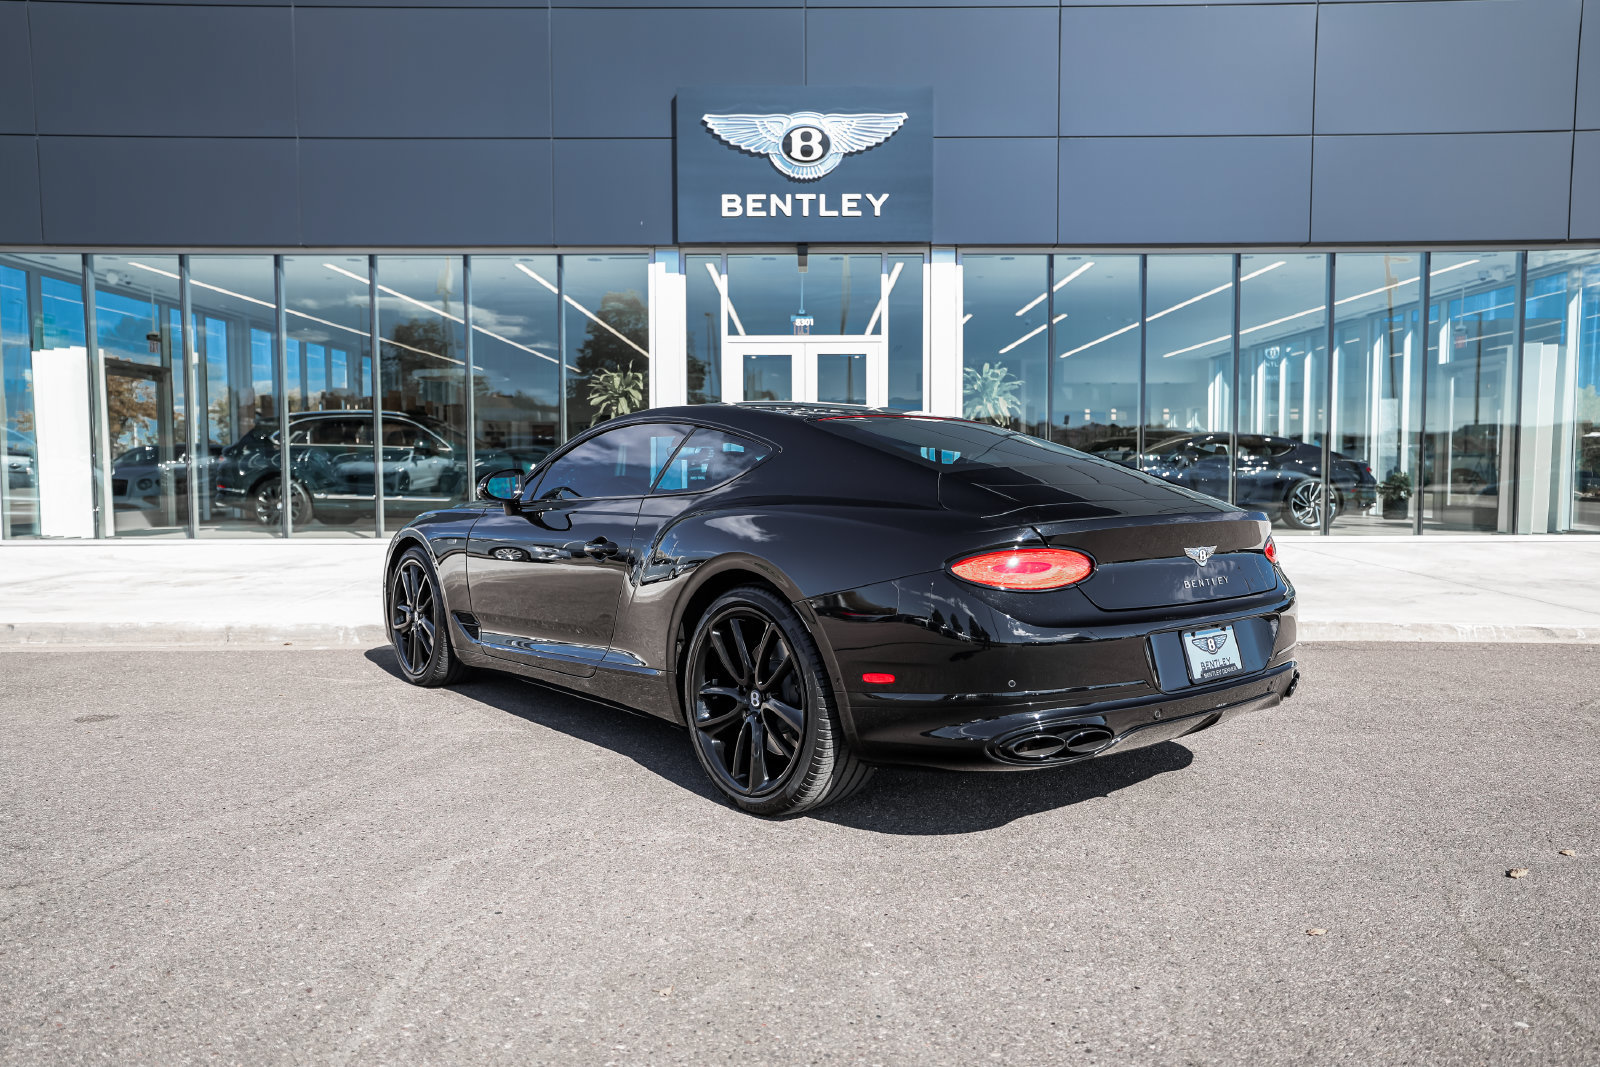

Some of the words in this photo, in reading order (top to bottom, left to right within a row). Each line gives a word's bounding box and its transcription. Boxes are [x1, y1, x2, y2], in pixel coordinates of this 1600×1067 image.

[789, 127, 823, 161] B
[721, 193, 889, 217] BENTLEY
[795, 318, 814, 326] 8301
[1184, 576, 1229, 589] BENTLEY
[1200, 656, 1231, 670] BENTLEY
